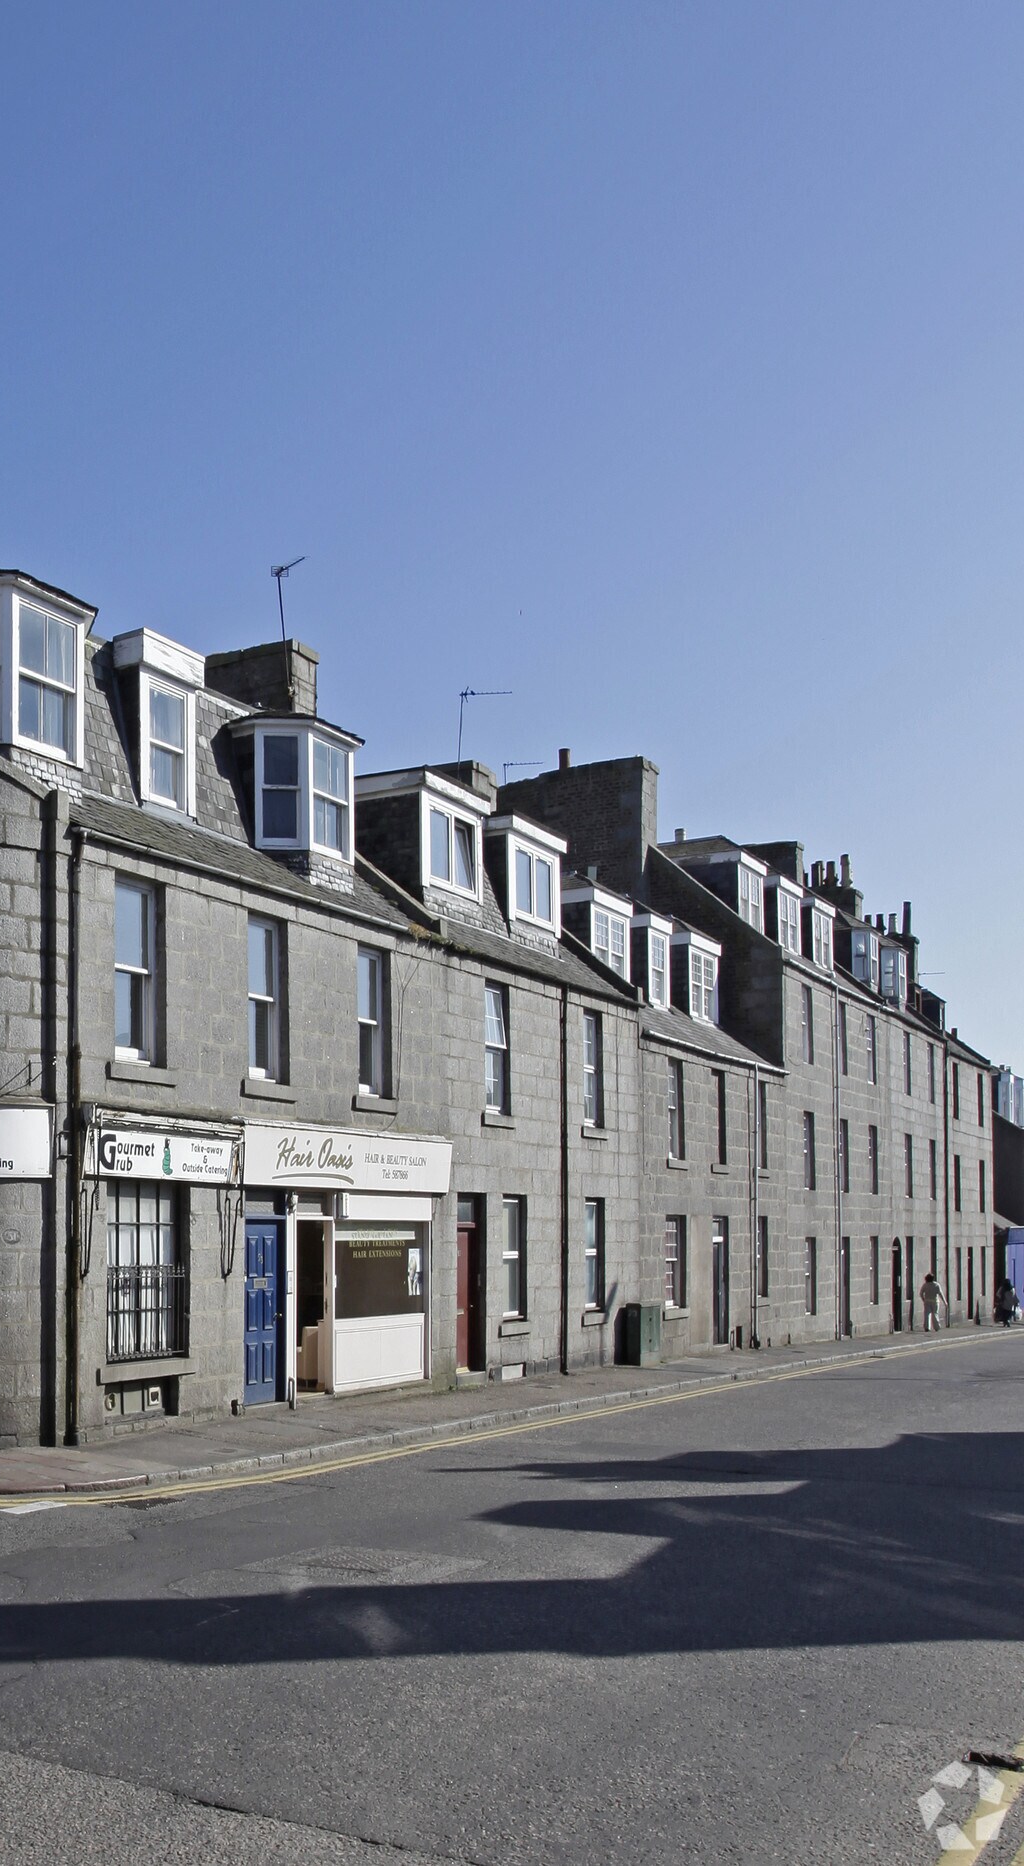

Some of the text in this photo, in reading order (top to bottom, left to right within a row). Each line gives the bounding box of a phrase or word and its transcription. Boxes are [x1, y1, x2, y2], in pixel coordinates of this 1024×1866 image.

[98, 1134, 155, 1170] Gourmet
[190, 1143, 224, 1156] Take-away
[276, 1136, 354, 1170] Hair Oasis
[202, 1155, 208, 1164] &
[364, 1153, 427, 1167] HAIR & BEAUTY SALON
[182, 1163, 228, 1177] Outside Catering
[352, 1250, 367, 1258] HAIR
[368, 1249, 402, 1258] EXTENSIONS
